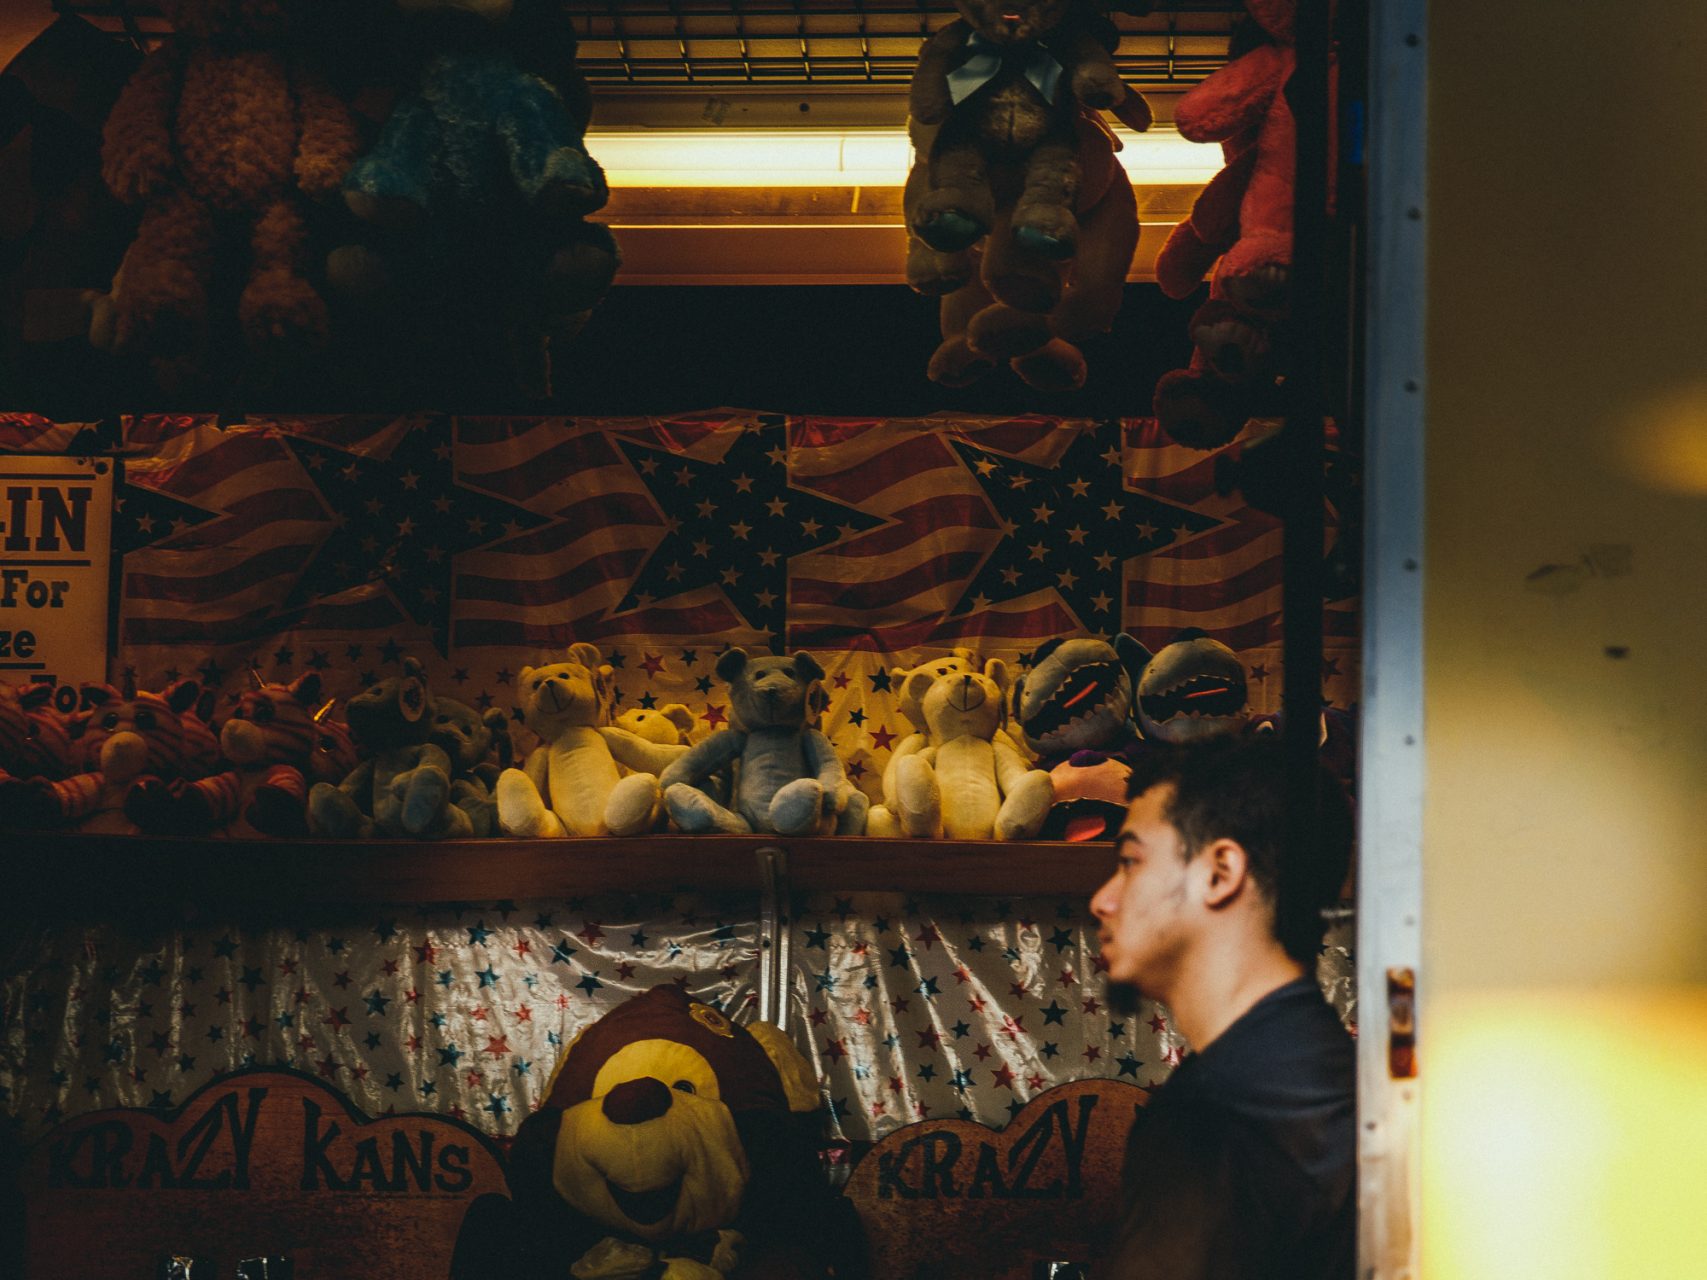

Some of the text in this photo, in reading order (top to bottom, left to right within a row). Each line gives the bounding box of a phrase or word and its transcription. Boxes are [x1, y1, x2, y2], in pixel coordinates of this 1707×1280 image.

[0, 486, 92, 551] IN
[2, 569, 69, 608] For
[47, 1087, 473, 1192] KRAZY KANS
[878, 1095, 1098, 1199] KRAZY
